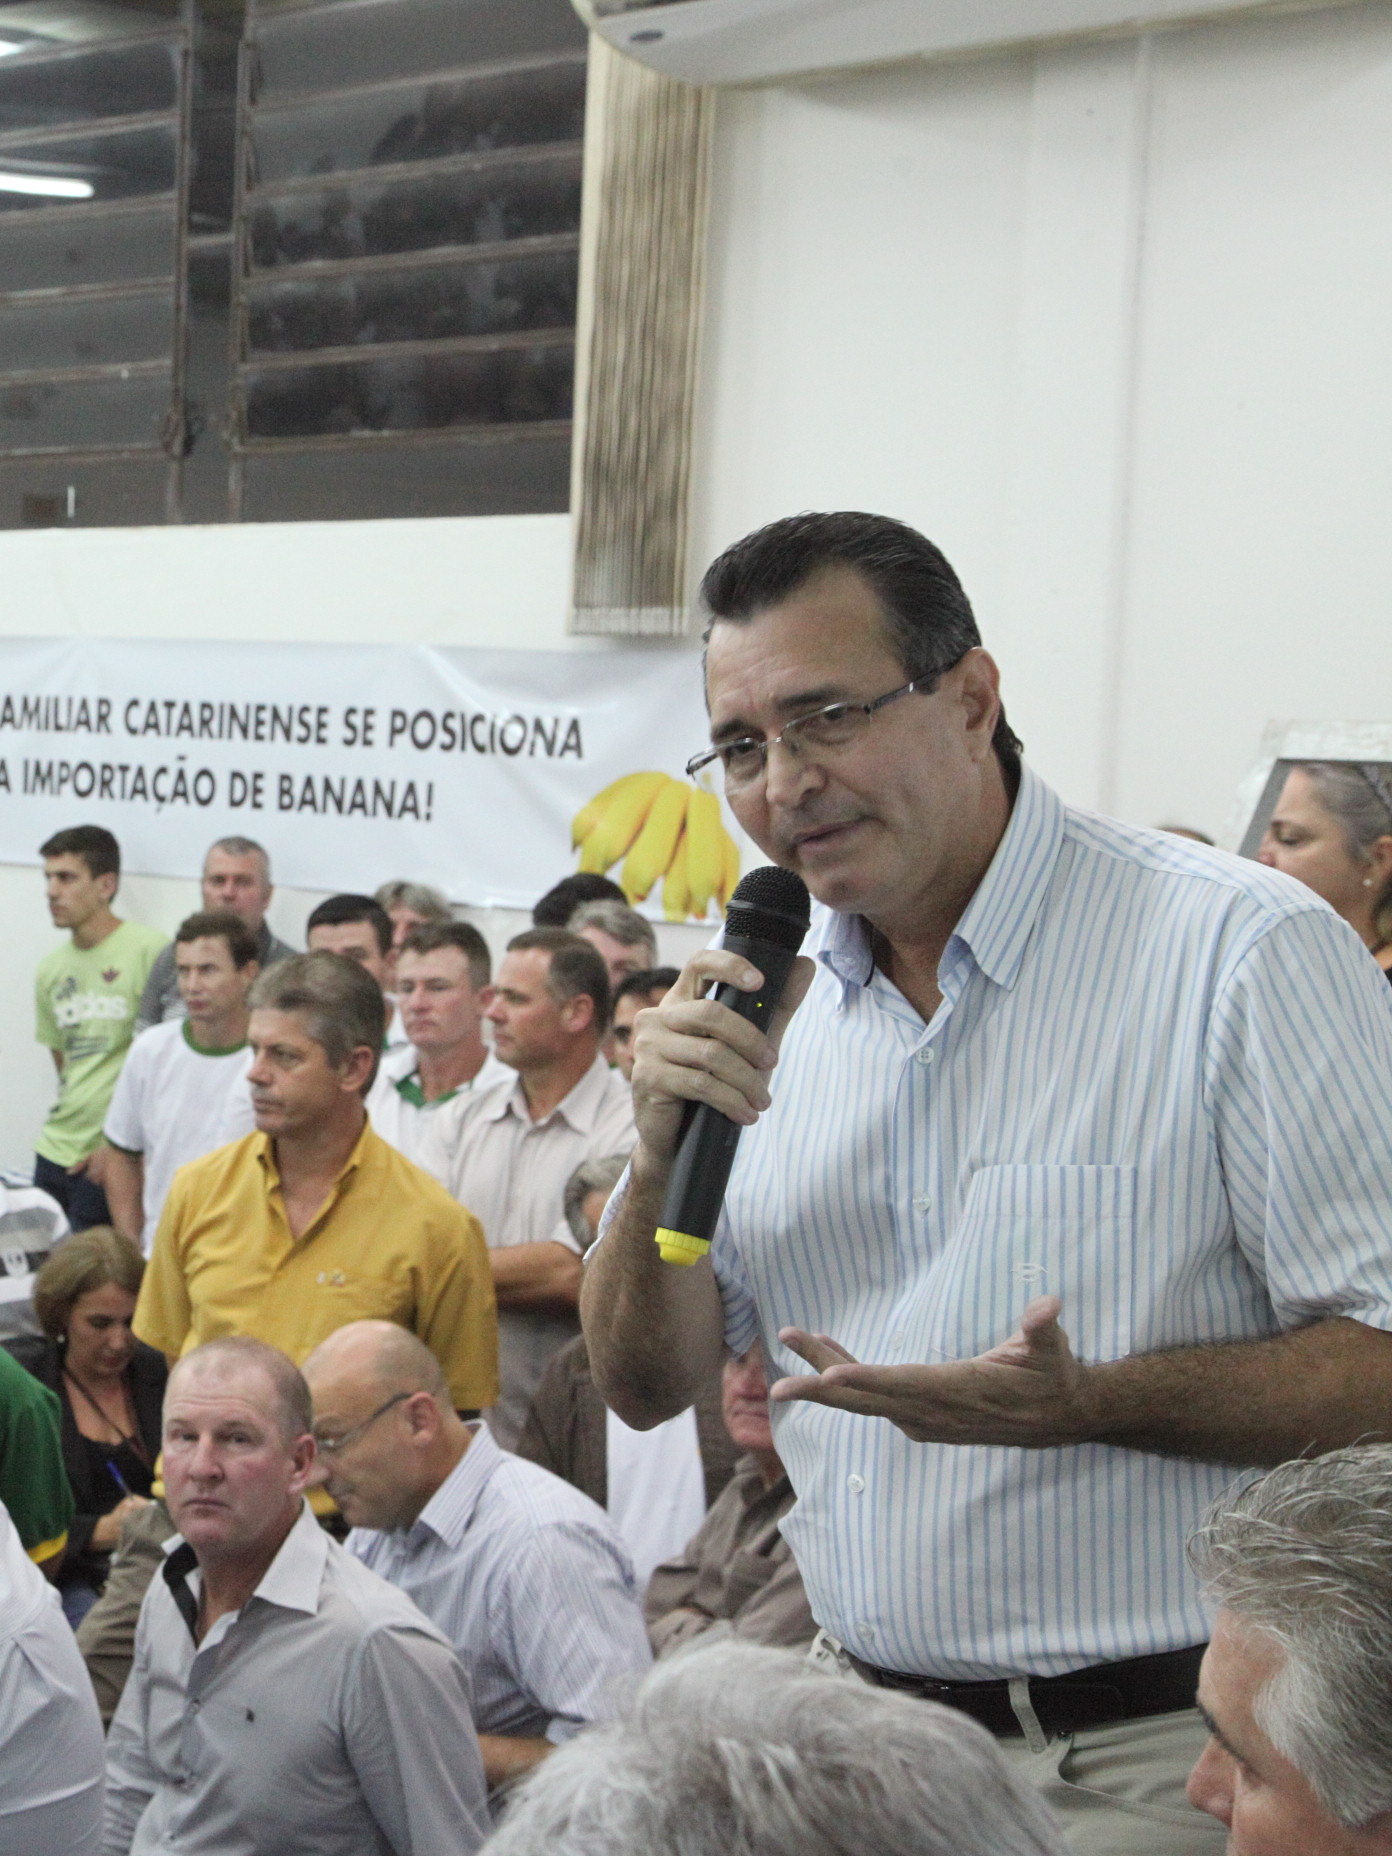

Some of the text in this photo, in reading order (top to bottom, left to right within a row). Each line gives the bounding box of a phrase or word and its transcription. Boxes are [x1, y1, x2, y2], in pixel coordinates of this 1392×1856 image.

[123, 698, 330, 746] CATARINENSE
[341, 705, 377, 748] SE
[388, 708, 584, 760] POSICIONA
[22, 754, 217, 814] IMPORTAÇÃO
[227, 769, 266, 812] DE
[276, 772, 435, 823] BANANA!
